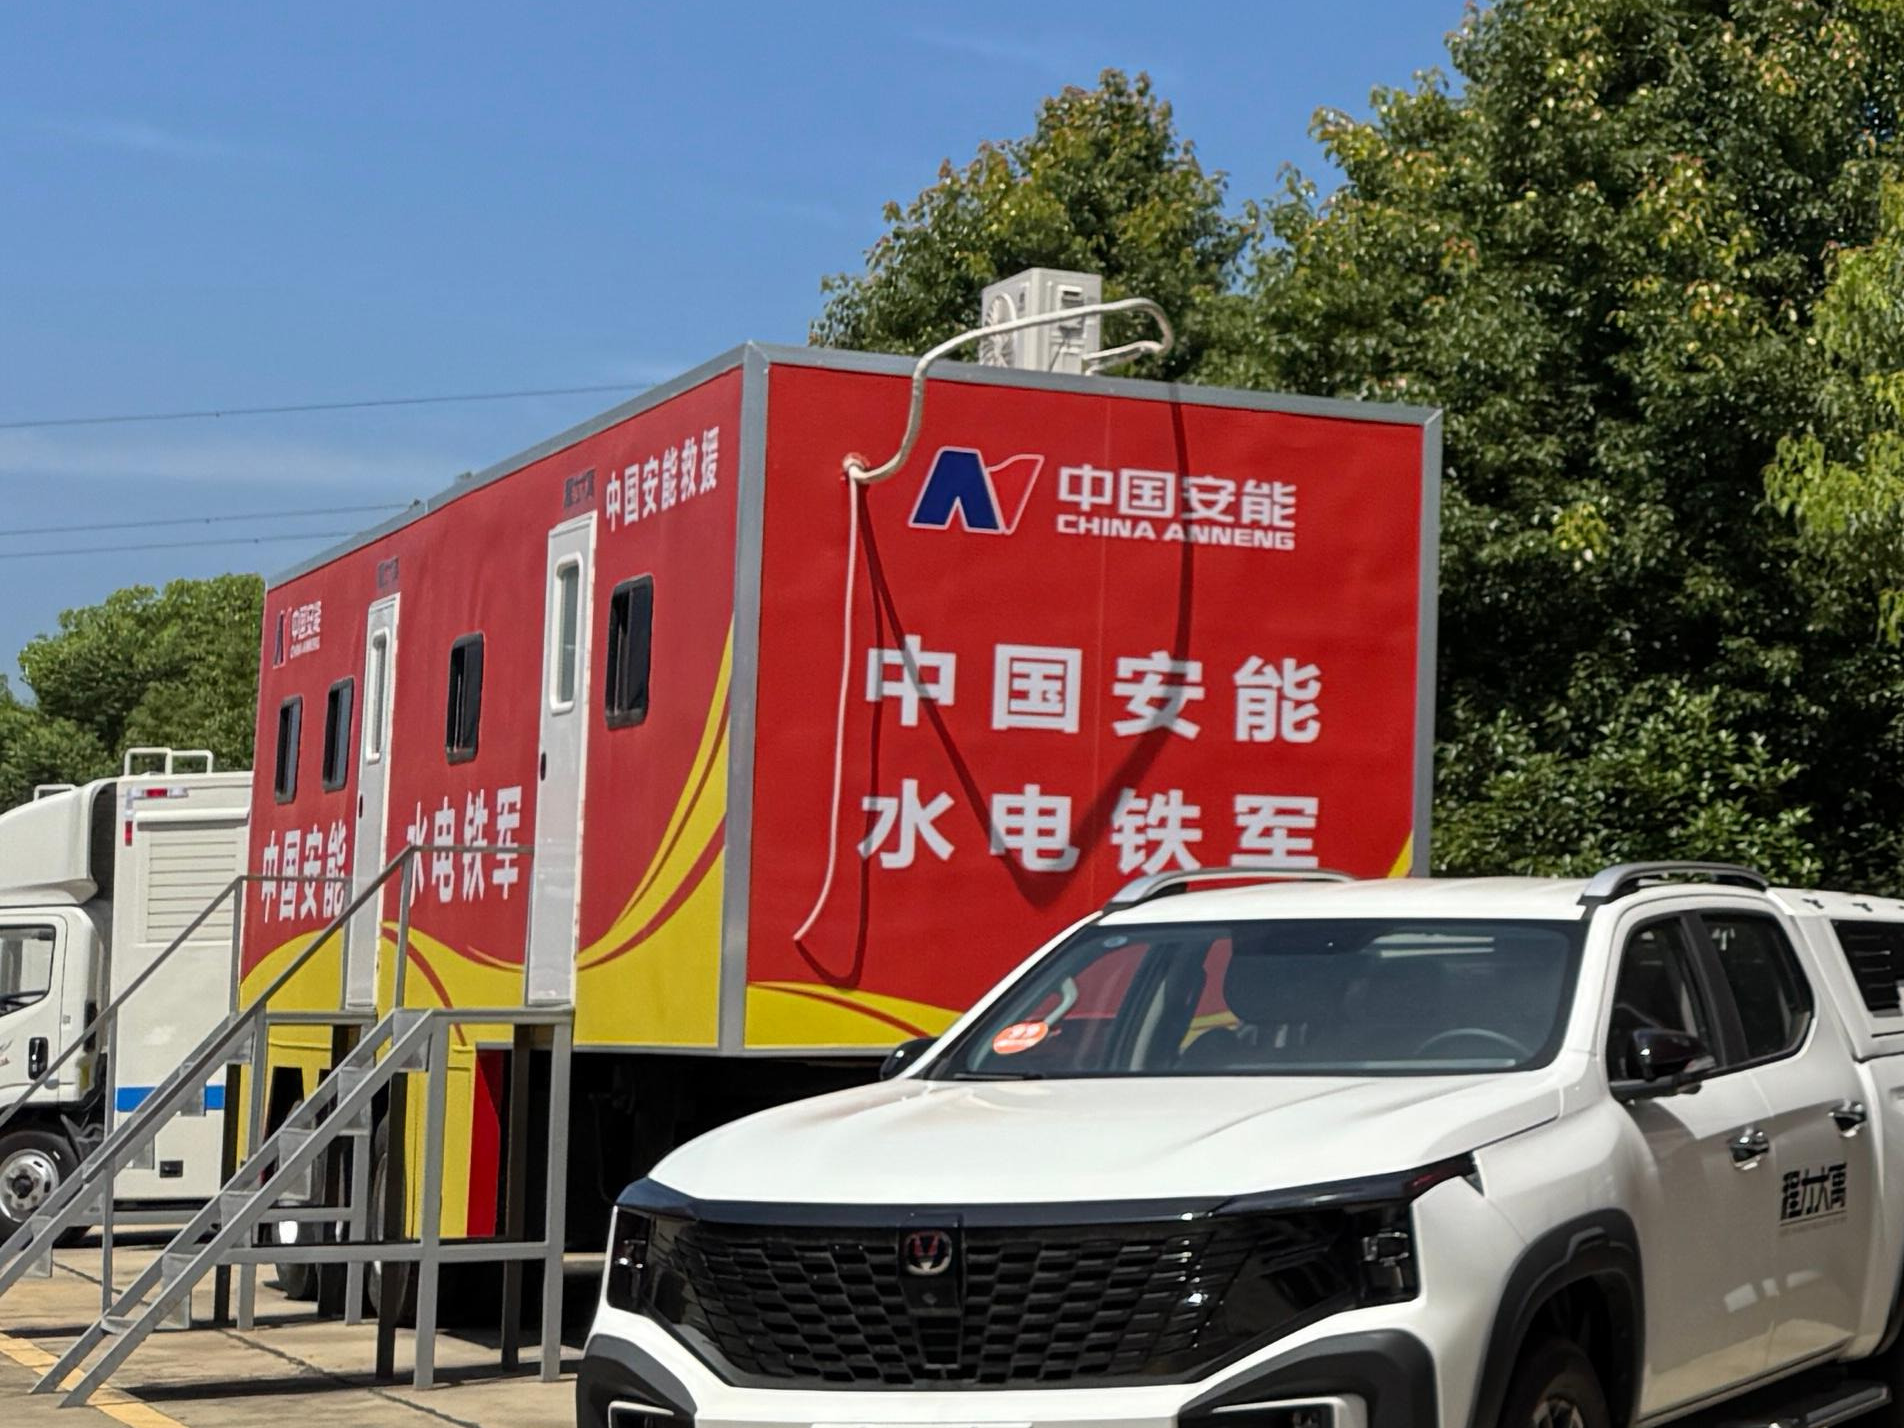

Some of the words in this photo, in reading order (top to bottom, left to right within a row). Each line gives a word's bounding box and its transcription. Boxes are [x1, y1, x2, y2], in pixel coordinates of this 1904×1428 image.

[606, 426, 720, 532] 中国安能救援
[1057, 464, 1297, 528] 中国安能
[1056, 514, 1156, 540] CHINA
[1162, 522, 1296, 551] ANNENG
[866, 634, 1323, 744] 中国安能
[261, 819, 347, 923] 中国安能
[407, 786, 522, 907] 水电铁军
[857, 779, 1320, 874] 水电铁军
